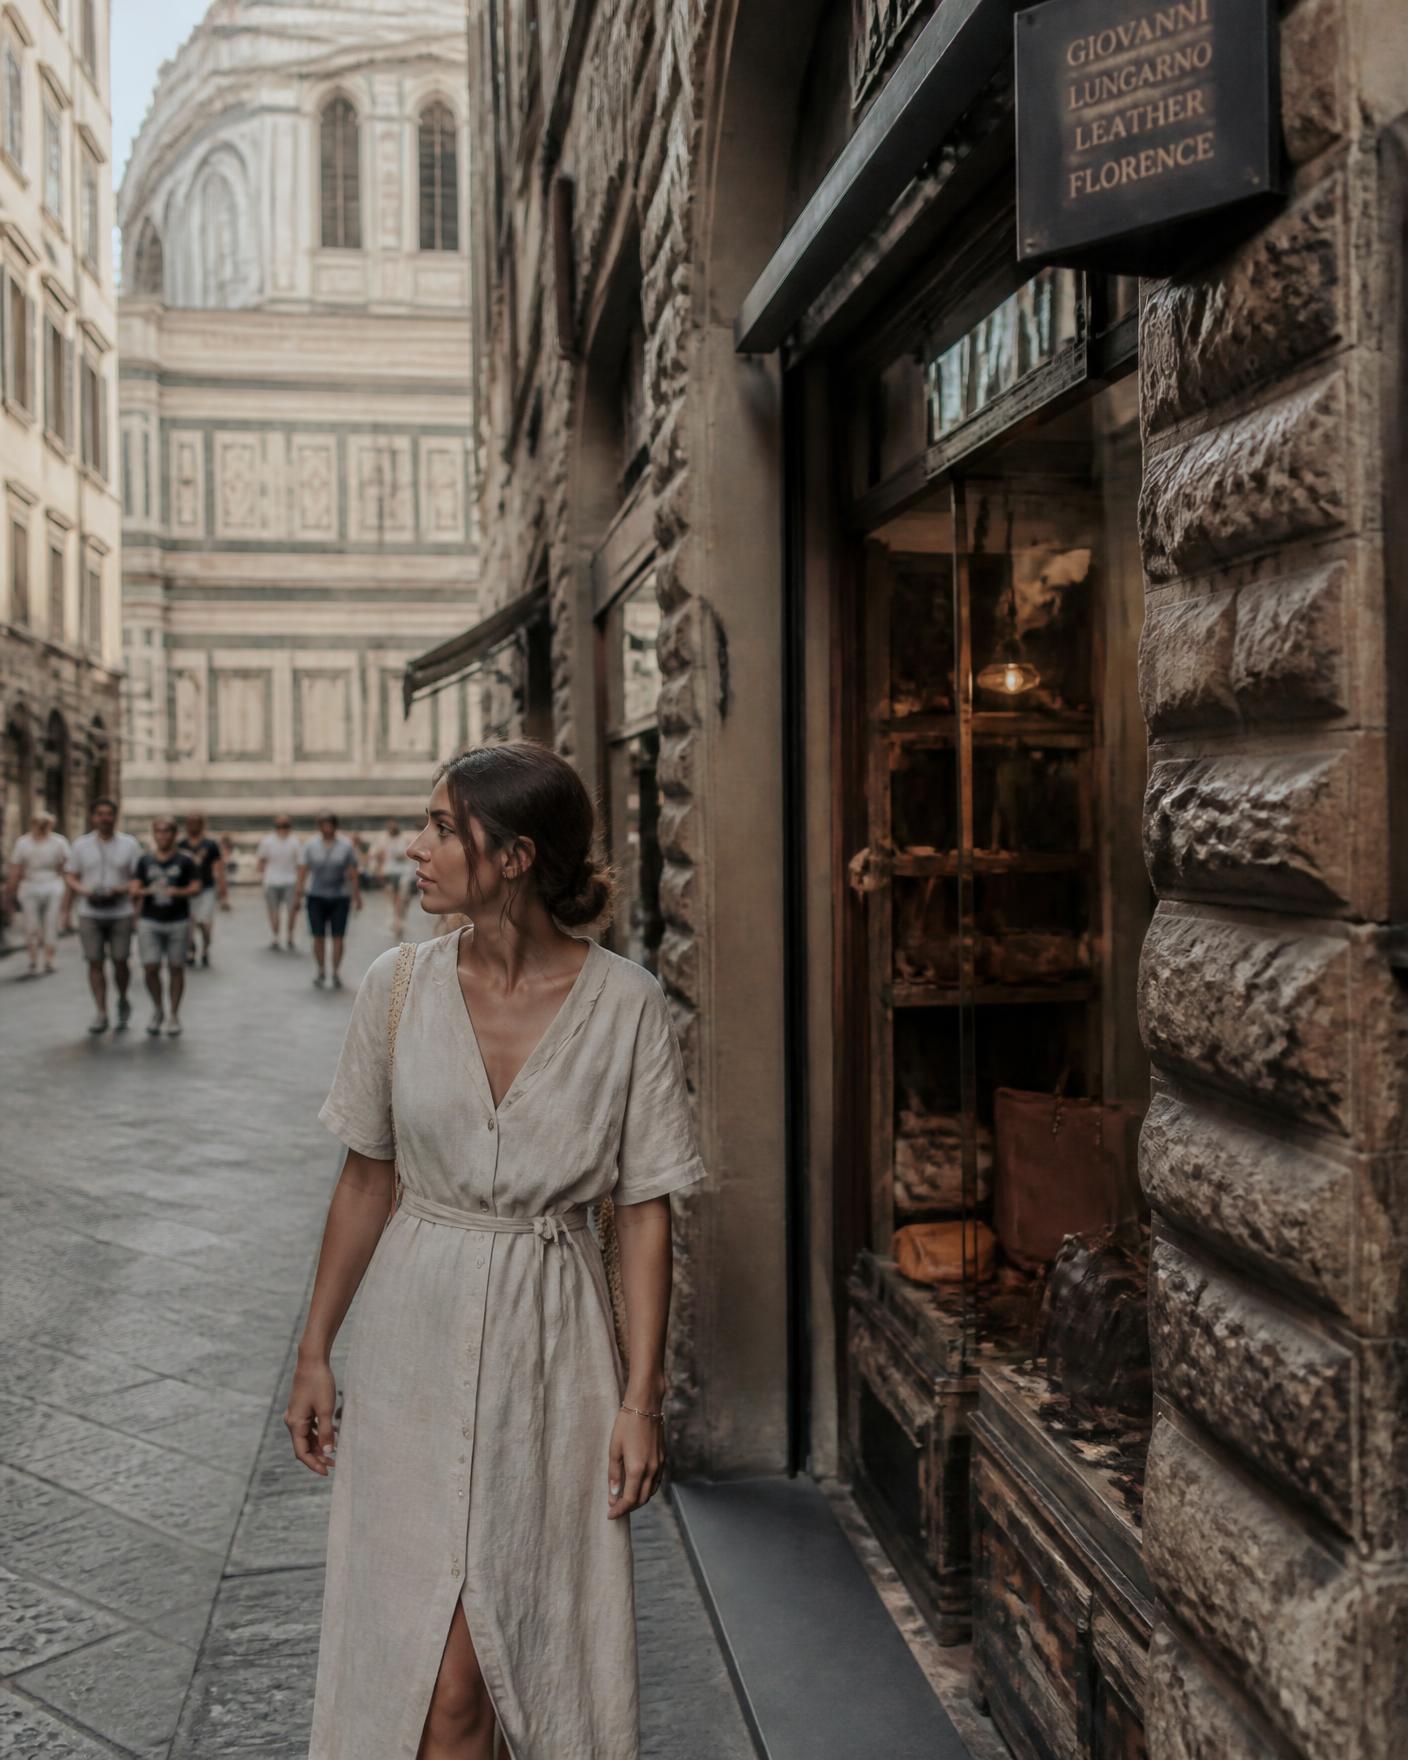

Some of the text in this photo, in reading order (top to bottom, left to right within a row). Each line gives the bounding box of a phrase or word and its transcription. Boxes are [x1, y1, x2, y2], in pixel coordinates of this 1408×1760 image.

[1068, 0, 1208, 66] GIOVANNI
[1069, 43, 1212, 110] LUNGARNO
[1076, 90, 1205, 150] LEATHER
[1069, 132, 1214, 197] FLORENCE
